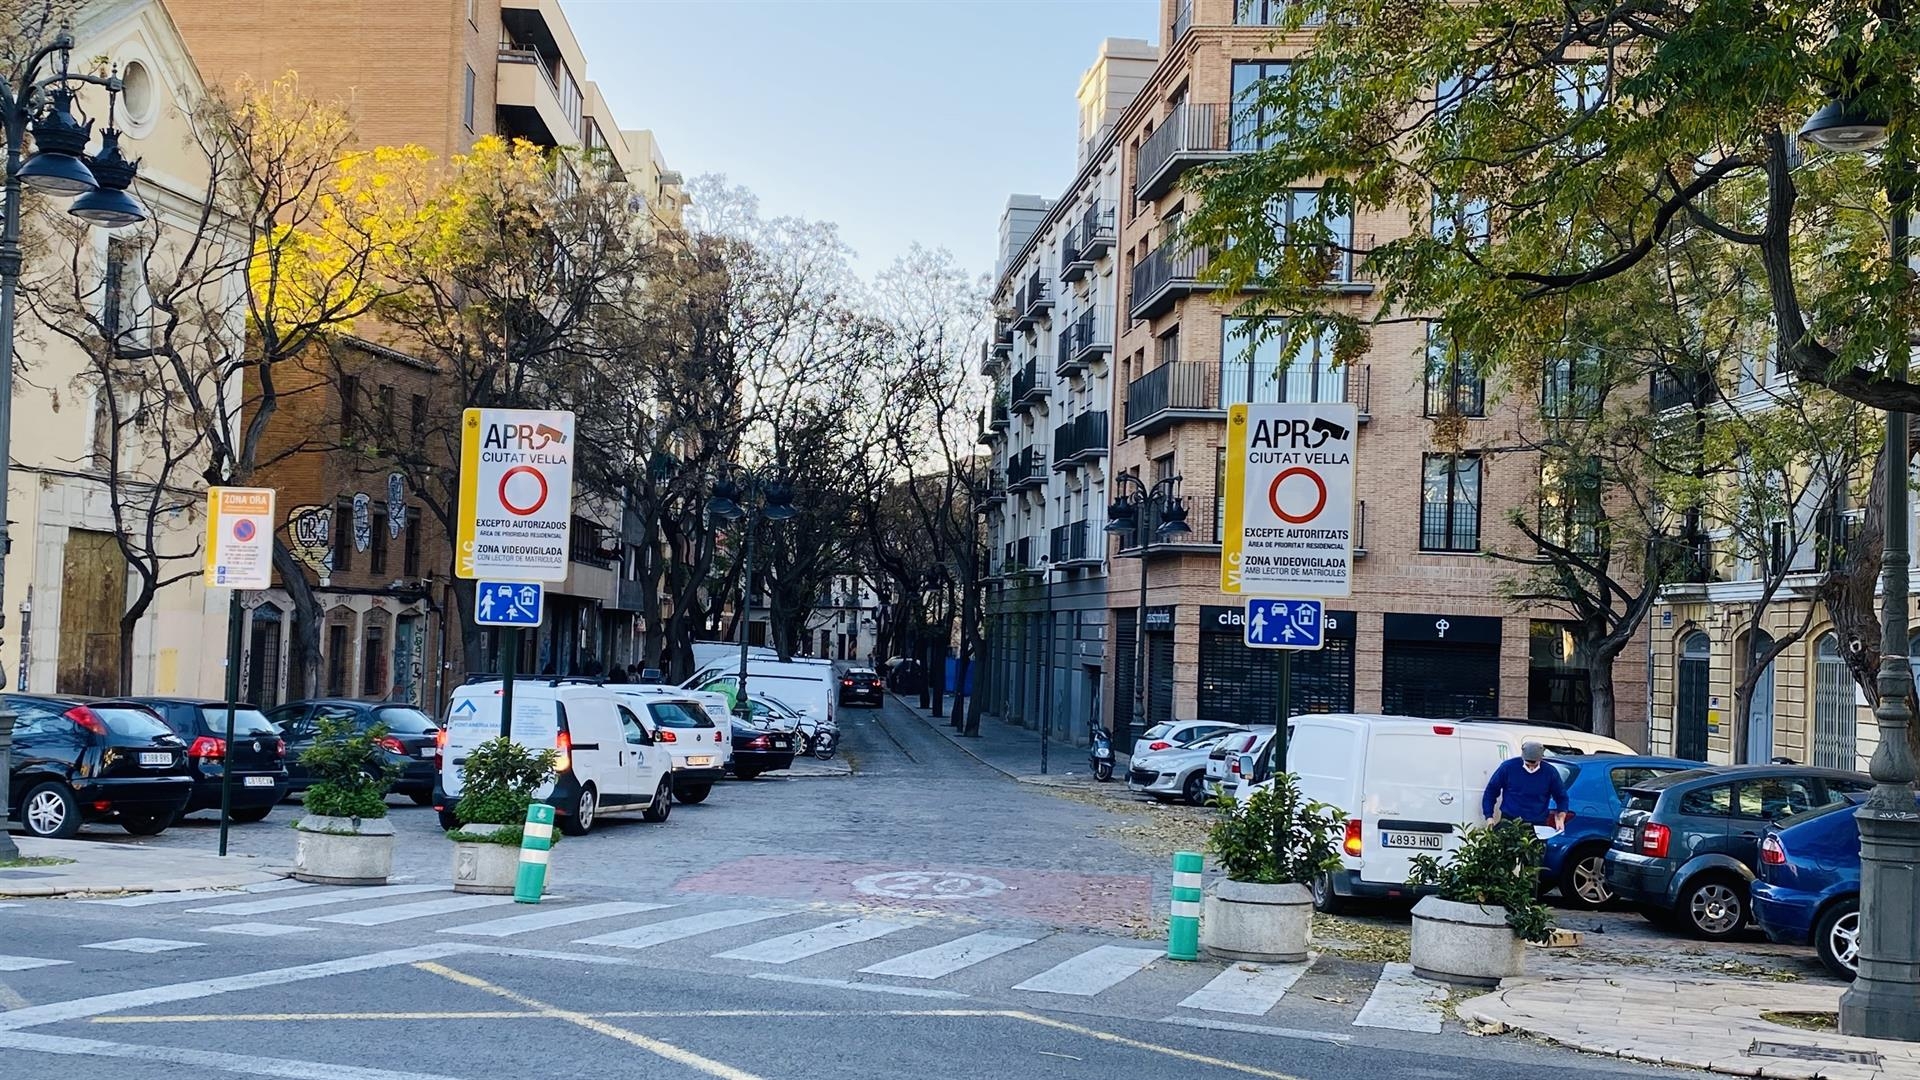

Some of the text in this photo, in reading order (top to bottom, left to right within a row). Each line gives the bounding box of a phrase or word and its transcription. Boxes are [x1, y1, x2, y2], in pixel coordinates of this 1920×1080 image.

[484, 423, 534, 449] APR
[1251, 419, 1311, 448] APR
[482, 452, 567, 464] CIUTAT VELLA
[1249, 452, 1349, 464] CIUTAT VELLA
[224, 494, 267, 504] ZONA ORA
[476, 519, 566, 530] EXCEPTO AUTORIZADOS
[1244, 528, 1348, 540] EXCEPTE AUTORITZATS
[477, 545, 562, 555] ZONA VIDEOVIGILADA
[1306, 542, 1344, 550] RESIDENCIAL
[462, 541, 474, 572] VLC
[1245, 556, 1346, 568] ZONA VIDEOVIGILADA
[1228, 552, 1241, 587] VLC
[1245, 566, 1260, 574] AMB
[1262, 567, 1289, 575] LECTOR
[1389, 834, 1416, 845] 4893
